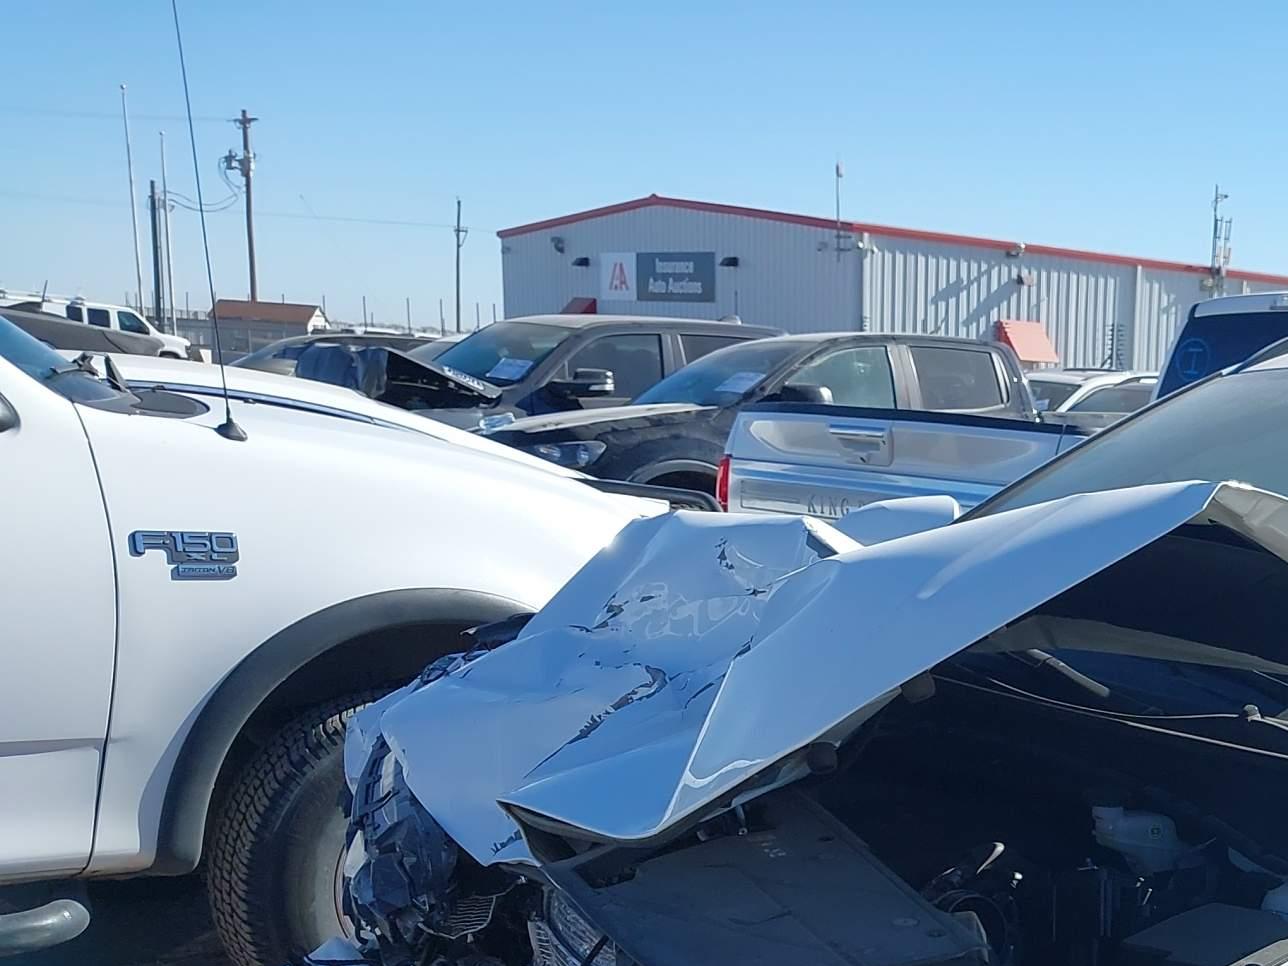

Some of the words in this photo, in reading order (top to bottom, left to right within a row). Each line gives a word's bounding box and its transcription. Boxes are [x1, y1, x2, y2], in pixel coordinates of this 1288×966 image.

[648, 277, 667, 294] Auto
[667, 277, 703, 295] Auctions
[185, 552, 228, 561] XL
[215, 565, 236, 576] V8
